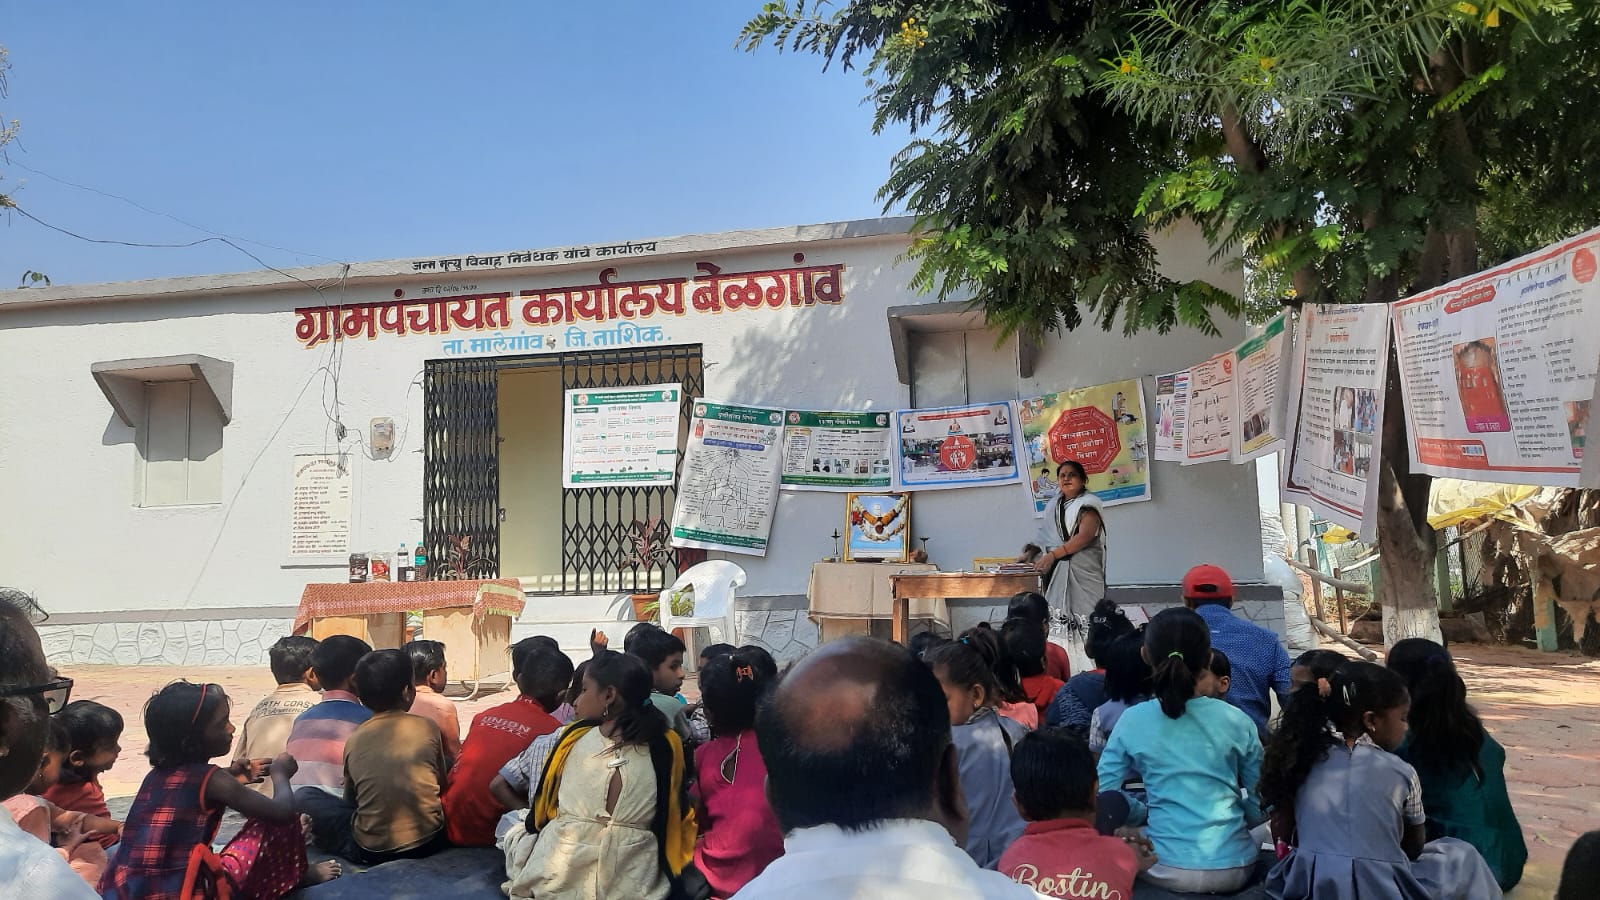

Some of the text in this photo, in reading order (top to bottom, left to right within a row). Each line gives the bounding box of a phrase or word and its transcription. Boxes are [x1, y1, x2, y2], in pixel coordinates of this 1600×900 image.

[466, 255, 504, 270] विवाह
[563, 246, 591, 259] यांचे
[596, 241, 658, 257] कार्यालय
[295, 252, 846, 349] ग्रामपंचायत कार्यालय बेळगांव
[480, 716, 531, 732] UNION
[1012, 863, 1121, 900] Bostin
